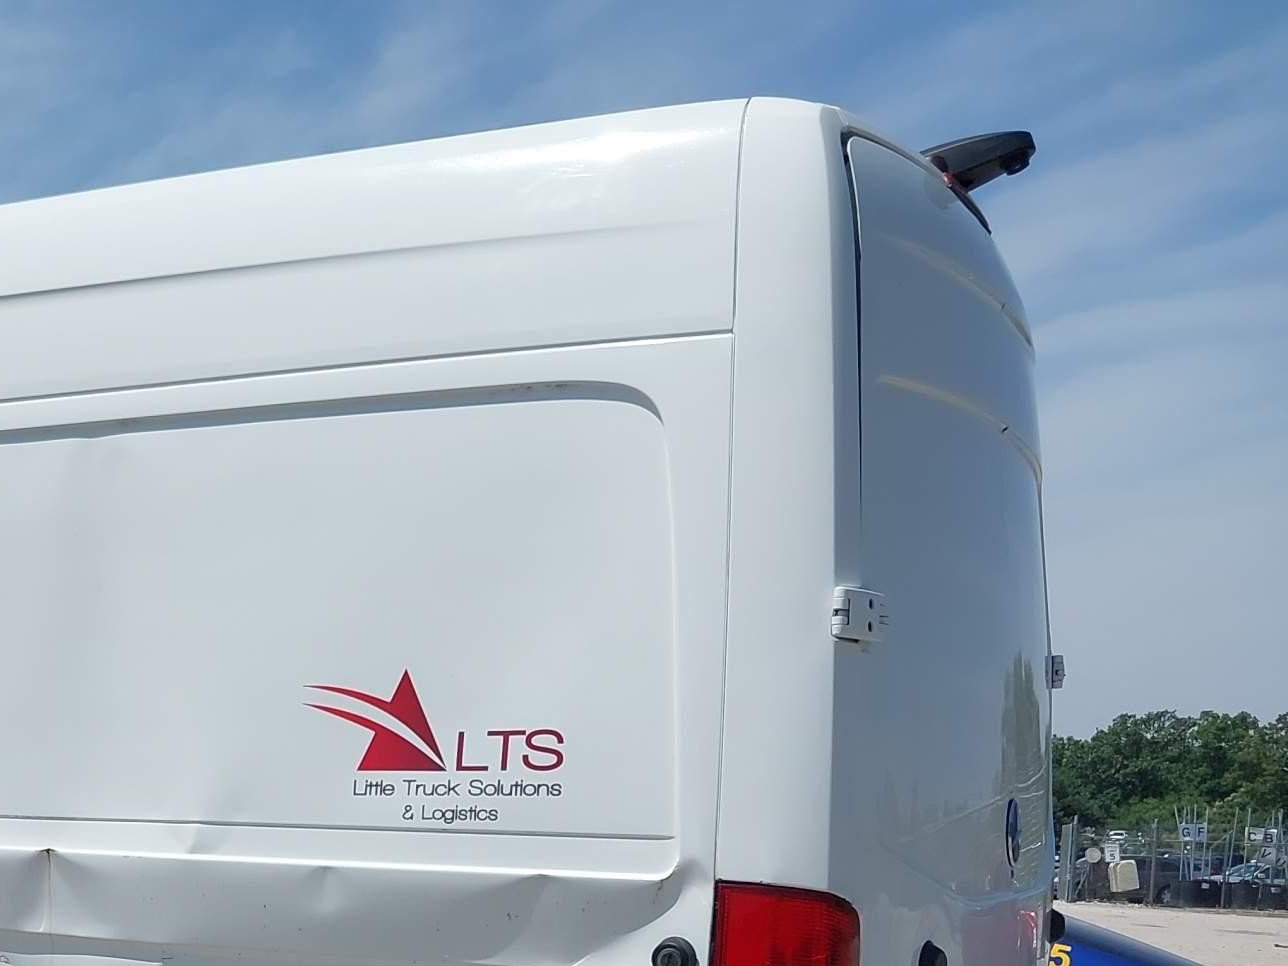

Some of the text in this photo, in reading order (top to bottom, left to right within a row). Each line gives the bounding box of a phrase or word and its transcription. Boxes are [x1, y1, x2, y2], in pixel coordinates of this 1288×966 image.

[455, 728, 565, 772] LTS
[352, 778, 563, 797] Little Truck Solutions
[401, 804, 499, 825] & Logistics
[1181, 827, 1191, 838] G
[1197, 827, 1206, 838] F
[1248, 831, 1257, 842] C
